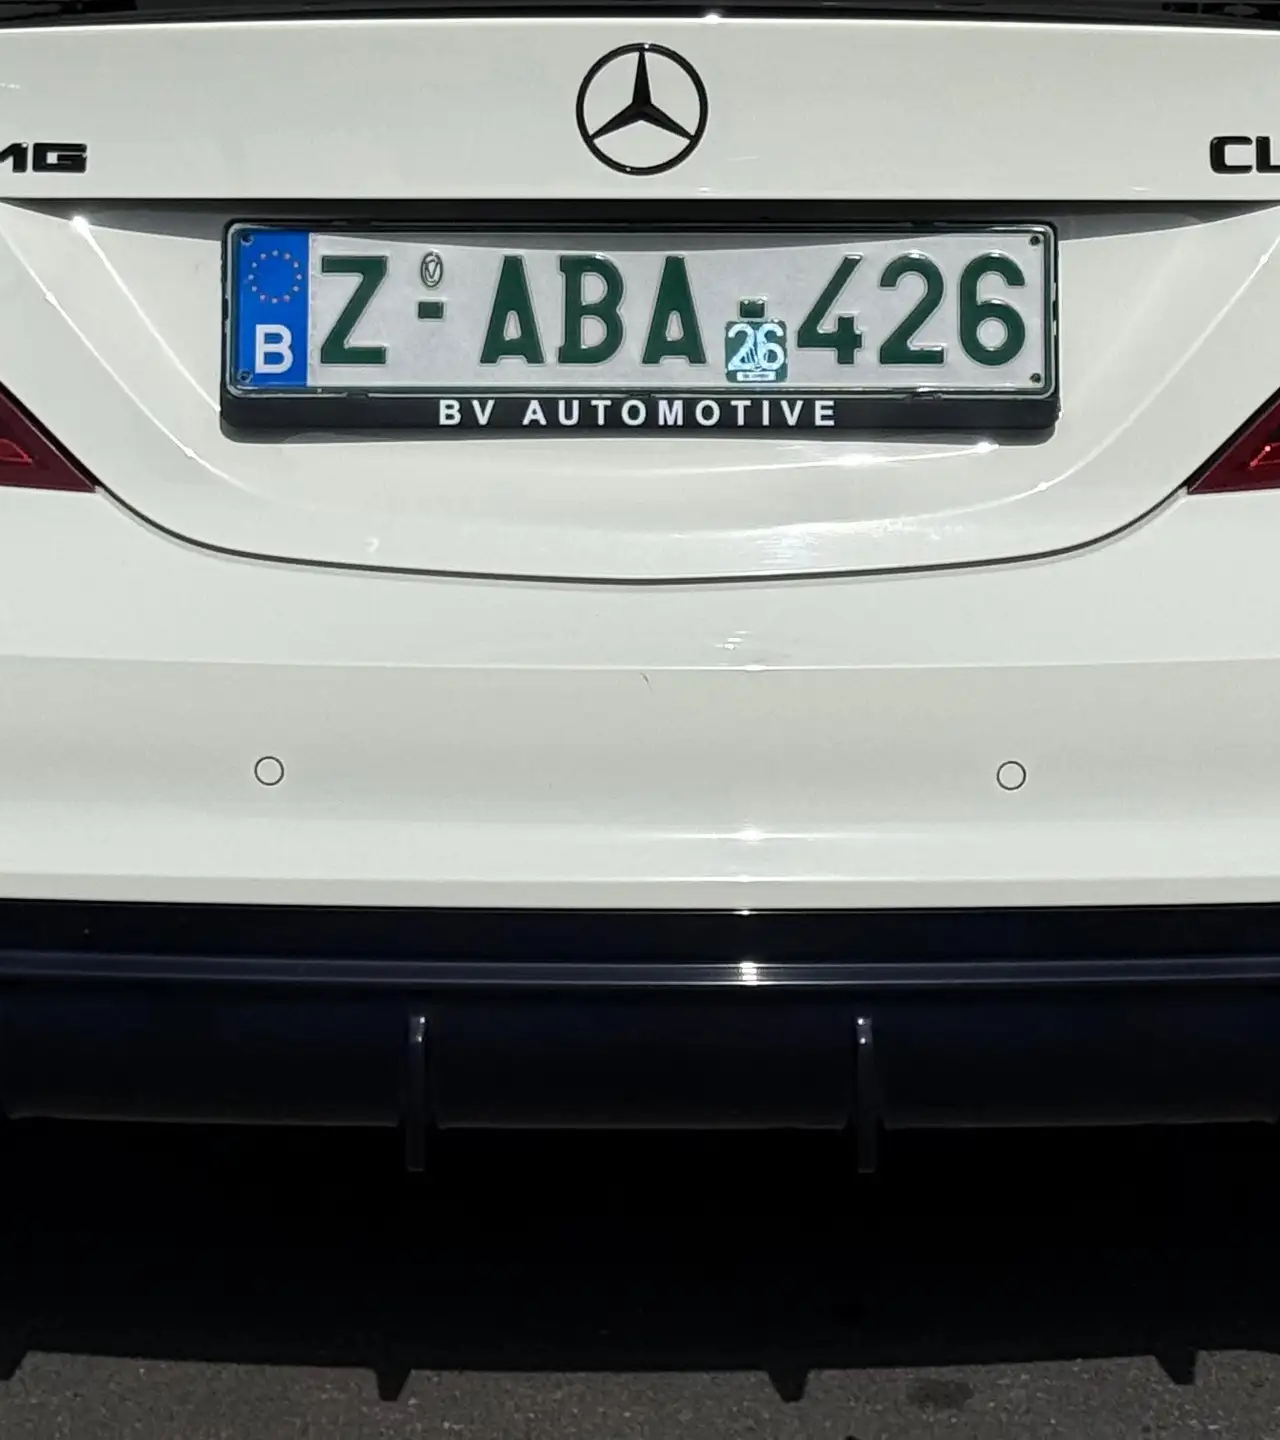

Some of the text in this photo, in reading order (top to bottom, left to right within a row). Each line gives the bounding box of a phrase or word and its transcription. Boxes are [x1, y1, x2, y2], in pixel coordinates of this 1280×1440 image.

[254, 324, 294, 374] B
[727, 323, 785, 371] 26
[438, 398, 836, 428] BV AUTOMOTIVE
